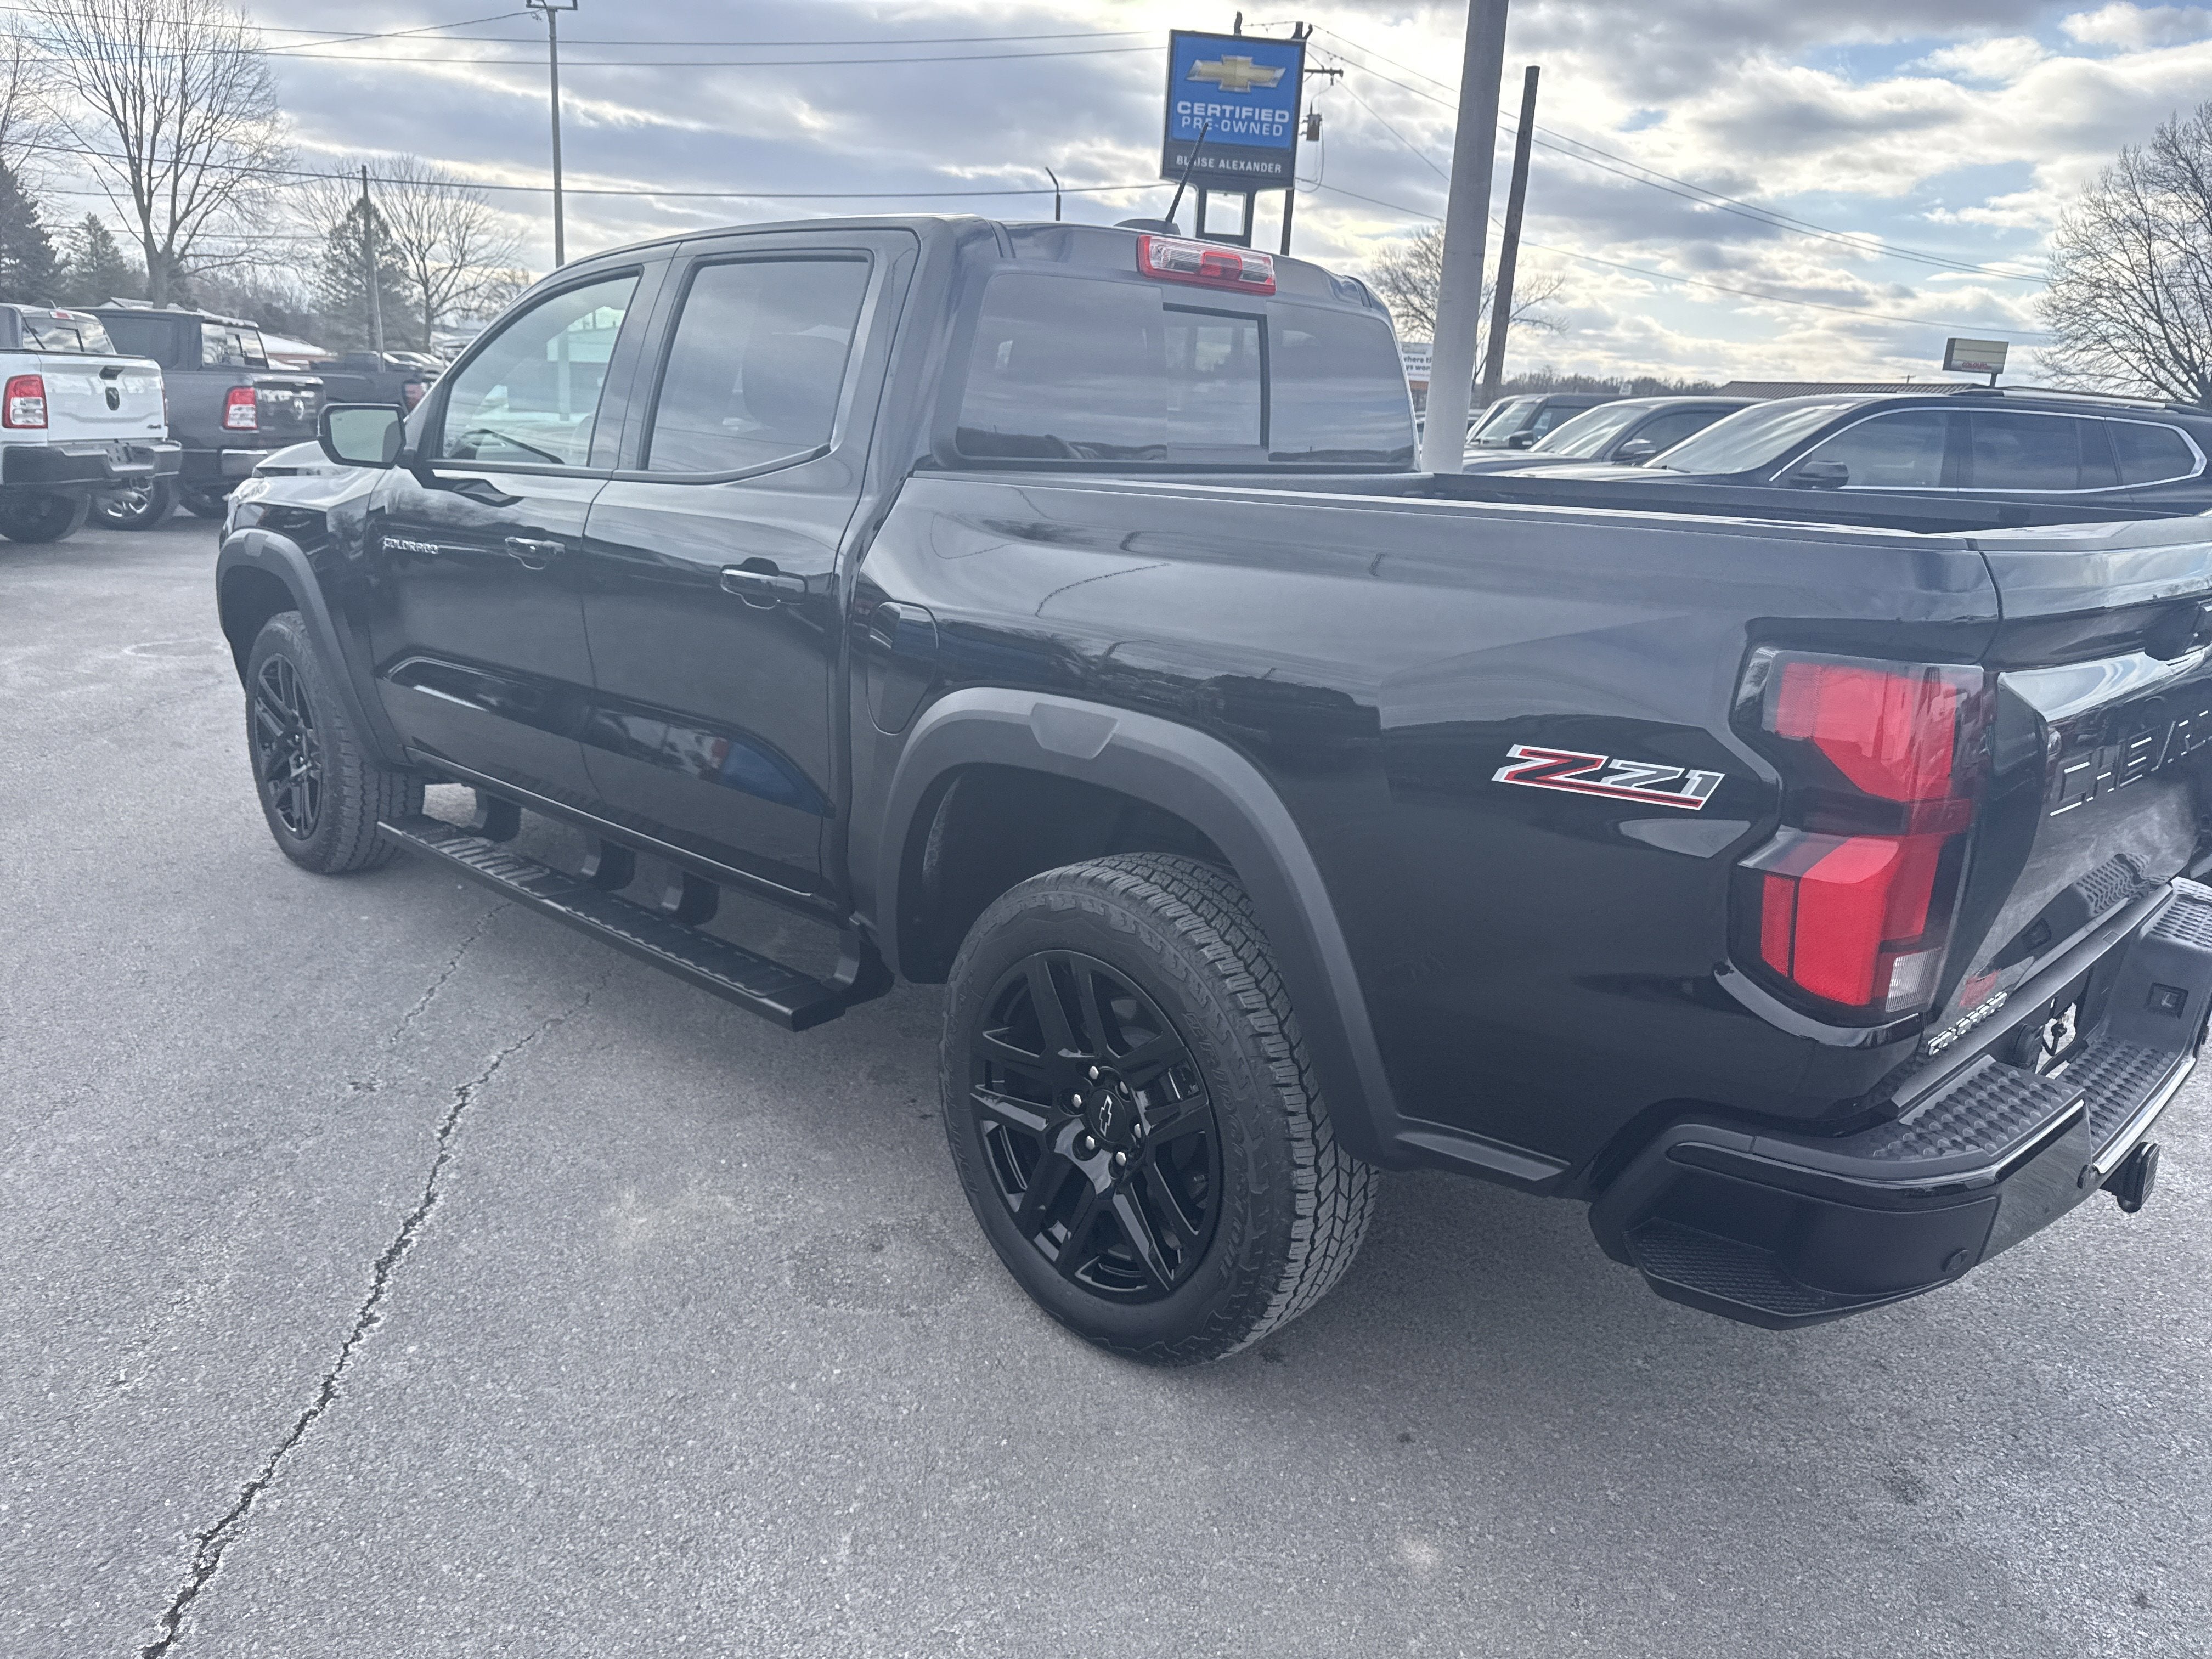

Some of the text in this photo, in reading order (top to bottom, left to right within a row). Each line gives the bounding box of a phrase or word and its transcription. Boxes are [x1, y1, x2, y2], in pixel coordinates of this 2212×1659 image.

[1177, 101, 1290, 123] CERTIFIED
[1181, 116, 1283, 137] PRE-OWNED
[1176, 155, 1282, 174] BLISE ALEXANDER
[383, 537, 438, 555] COLORADO
[1491, 744, 1725, 811] Z71
